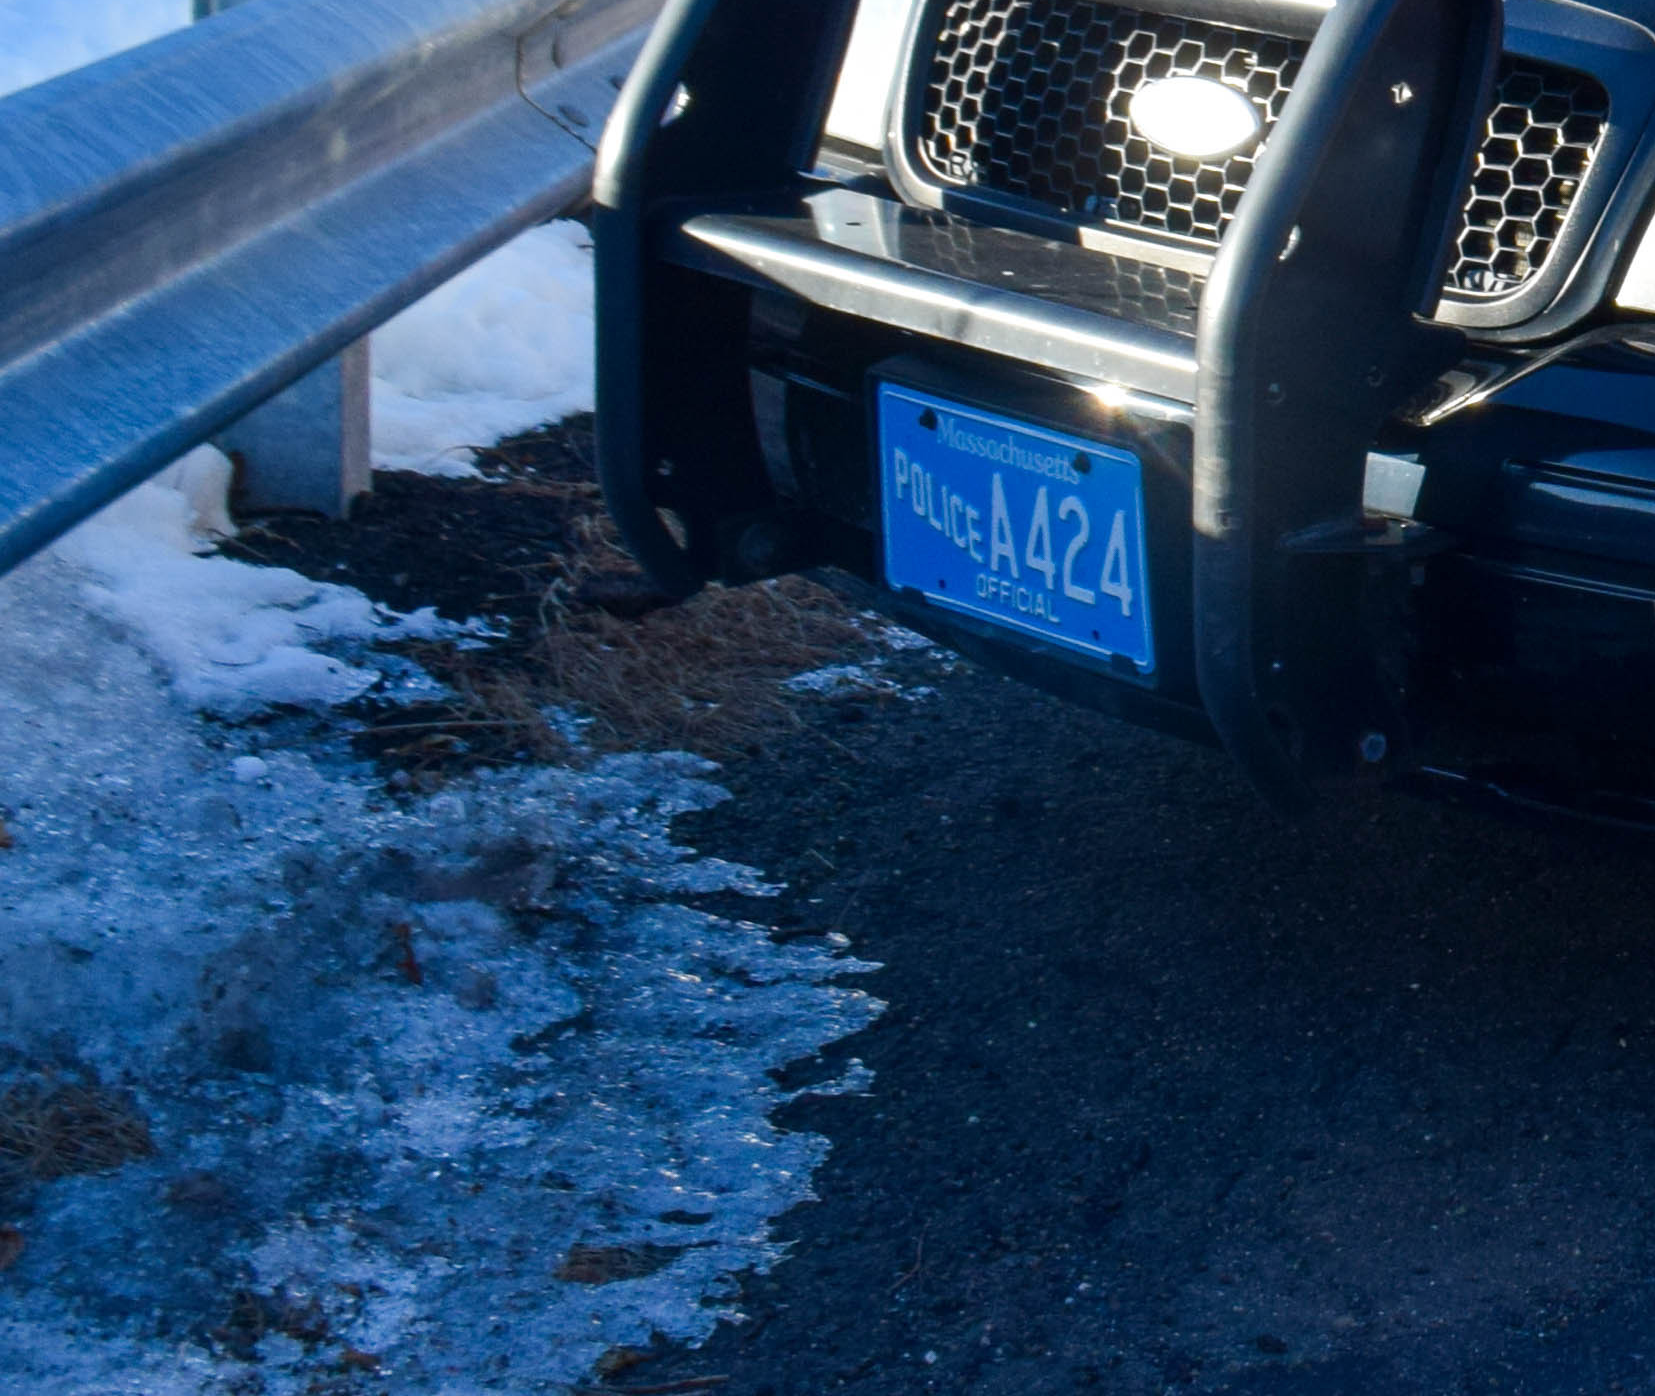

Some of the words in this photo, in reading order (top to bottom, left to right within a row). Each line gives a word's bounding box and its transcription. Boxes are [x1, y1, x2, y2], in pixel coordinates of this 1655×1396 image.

[936, 412, 1081, 485] Massachusetts
[894, 447, 985, 564] POLICE
[989, 472, 1134, 617] A424
[976, 573, 1060, 624] OFFICIAL
